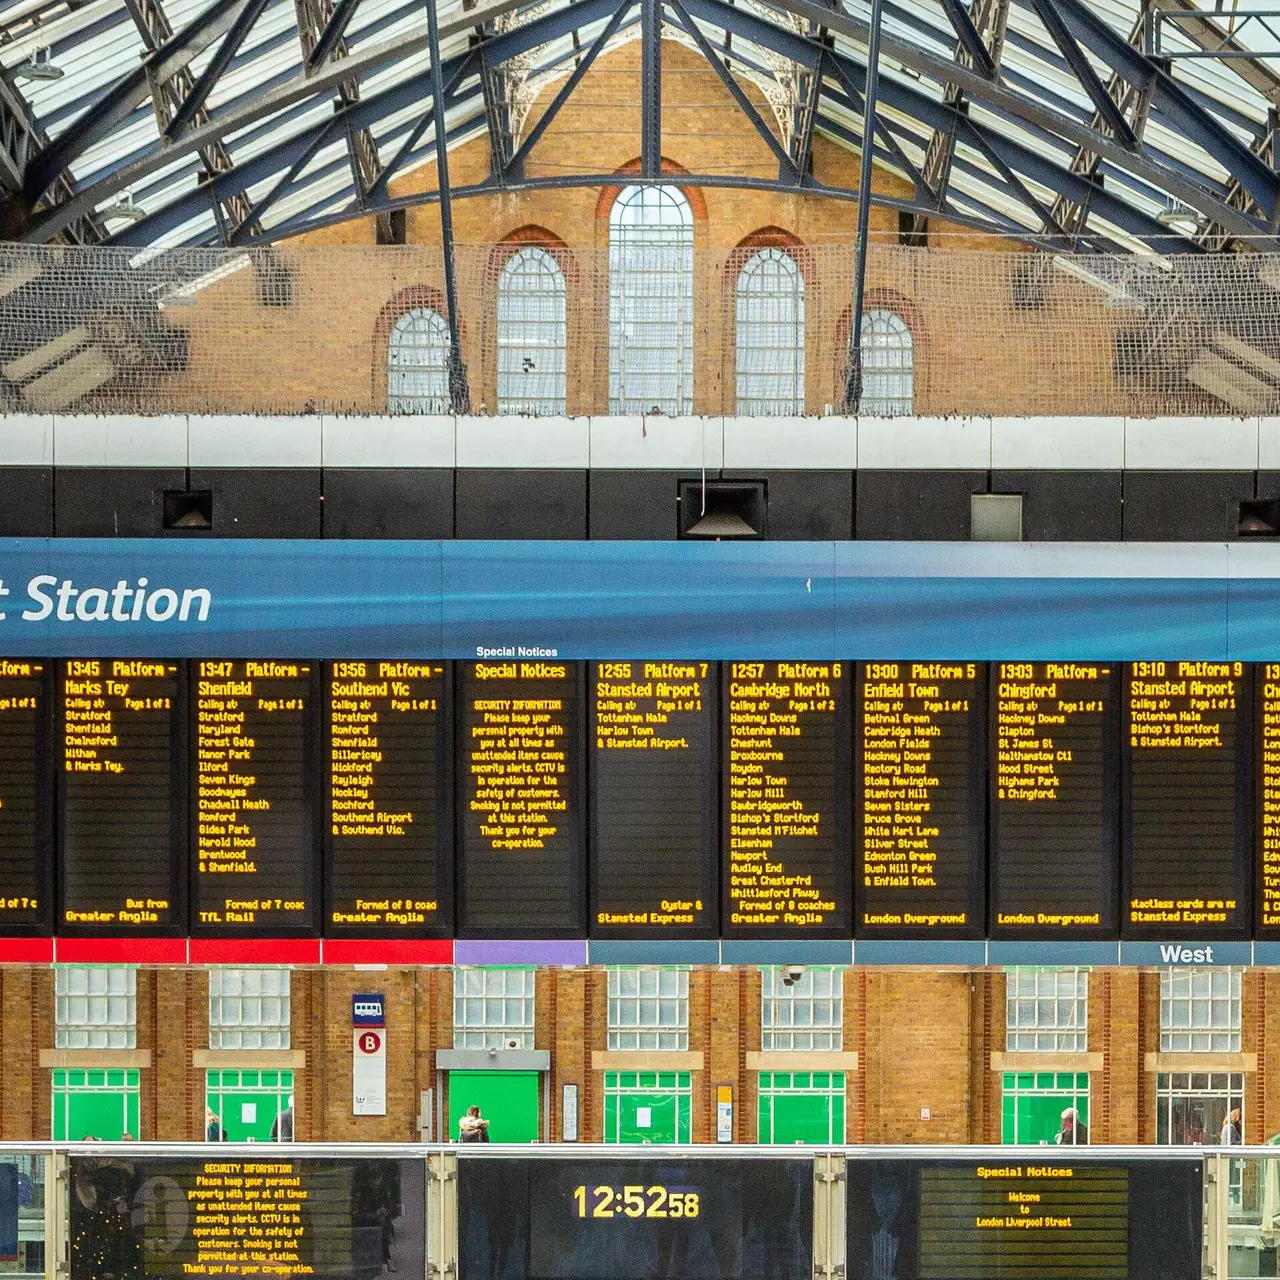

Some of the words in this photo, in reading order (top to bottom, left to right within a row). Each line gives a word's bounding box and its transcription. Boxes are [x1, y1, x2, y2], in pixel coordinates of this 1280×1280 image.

[22, 576, 210, 620] Station
[477, 647, 514, 657] Special
[518, 647, 557, 656] Notices
[476, 664, 516, 679] Special
[521, 664, 565, 678] Notices
[599, 664, 631, 678] 12:55
[645, 664, 695, 678] Platform
[700, 664, 708, 678] 7
[866, 664, 898, 678] 13:00
[912, 664, 962, 678] Platform
[967, 664, 975, 678] 5
[598, 682, 652, 697] Stansted
[656, 682, 700, 698] Airport
[865, 683, 903, 698] Enfield
[908, 683, 938, 697] Town
[999, 683, 1056, 699] Chingford
[1160, 945, 1213, 962] West
[977, 1167, 1022, 1178] Special
[1027, 1167, 1073, 1176] Notices
[1009, 1192, 1040, 1206] Welcome
[976, 1217, 1004, 1226] London
[1006, 1217, 1042, 1228] Liverpool
[1045, 1217, 1072, 1226] Street
